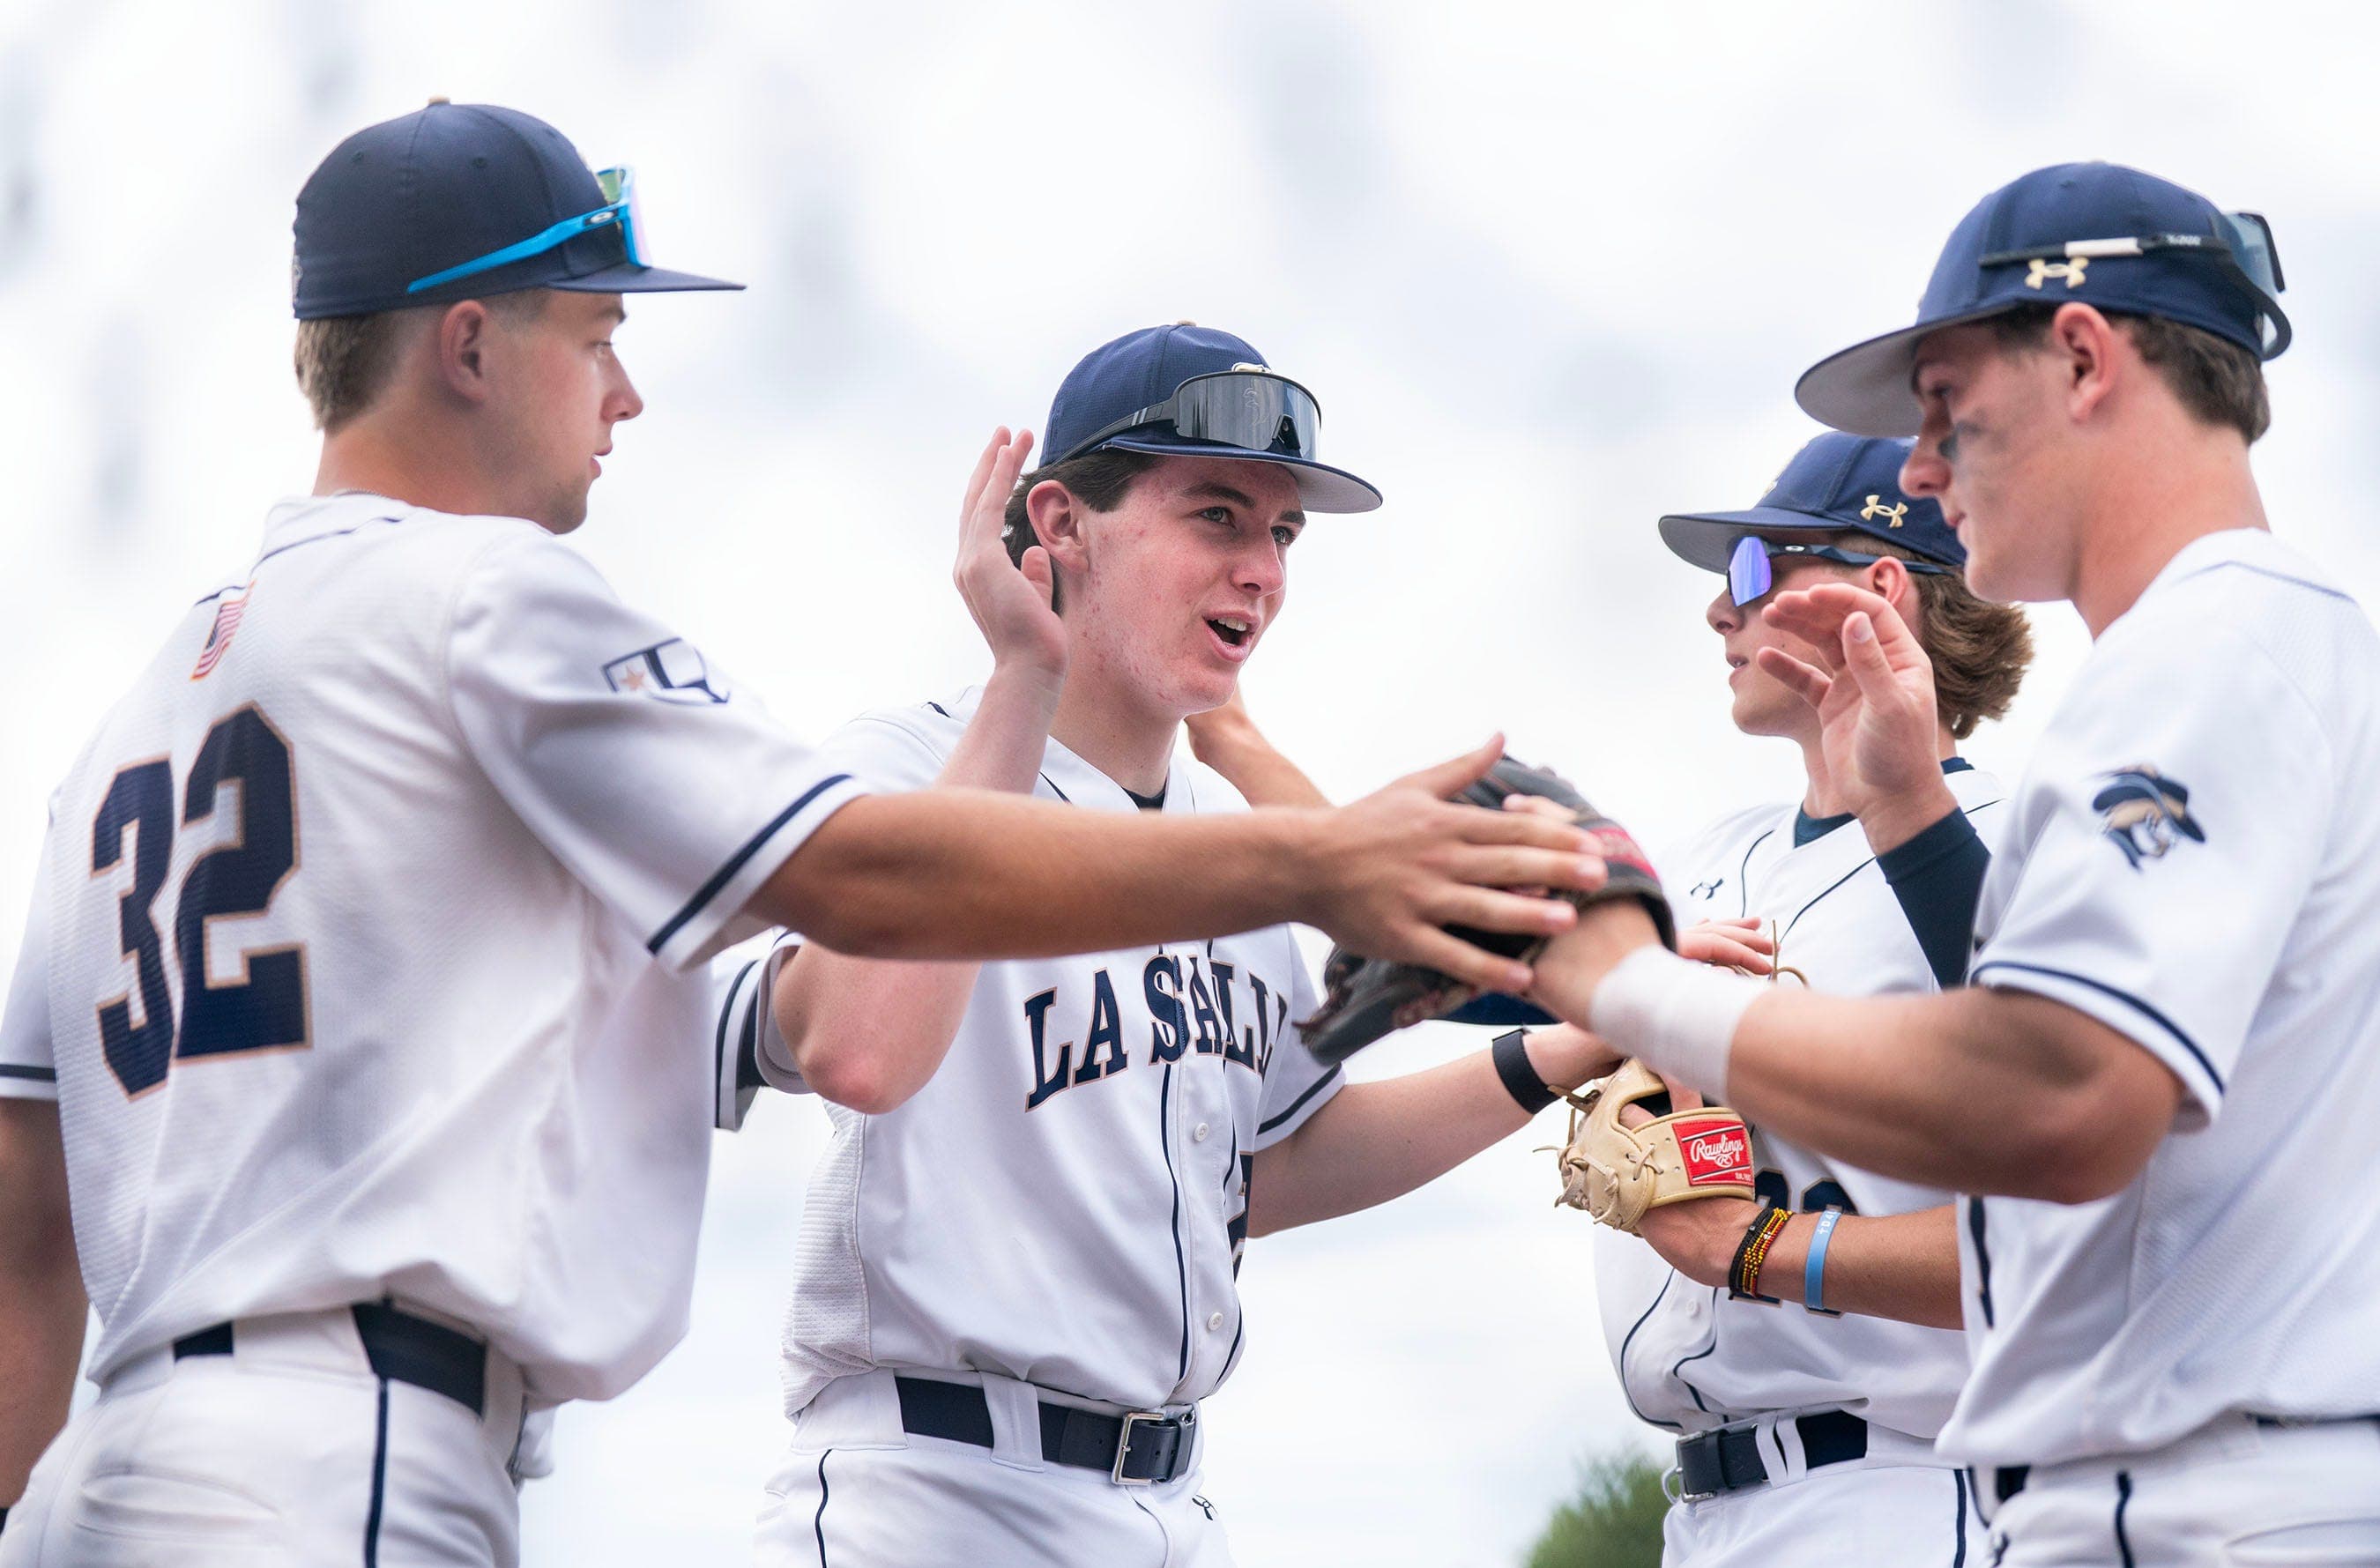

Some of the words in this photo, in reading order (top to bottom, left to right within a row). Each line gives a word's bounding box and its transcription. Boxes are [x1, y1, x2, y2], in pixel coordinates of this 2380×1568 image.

[90, 700, 312, 1103] 32
[1024, 966, 1129, 1113] LA
[1690, 1133, 1744, 1163] Rawlings
